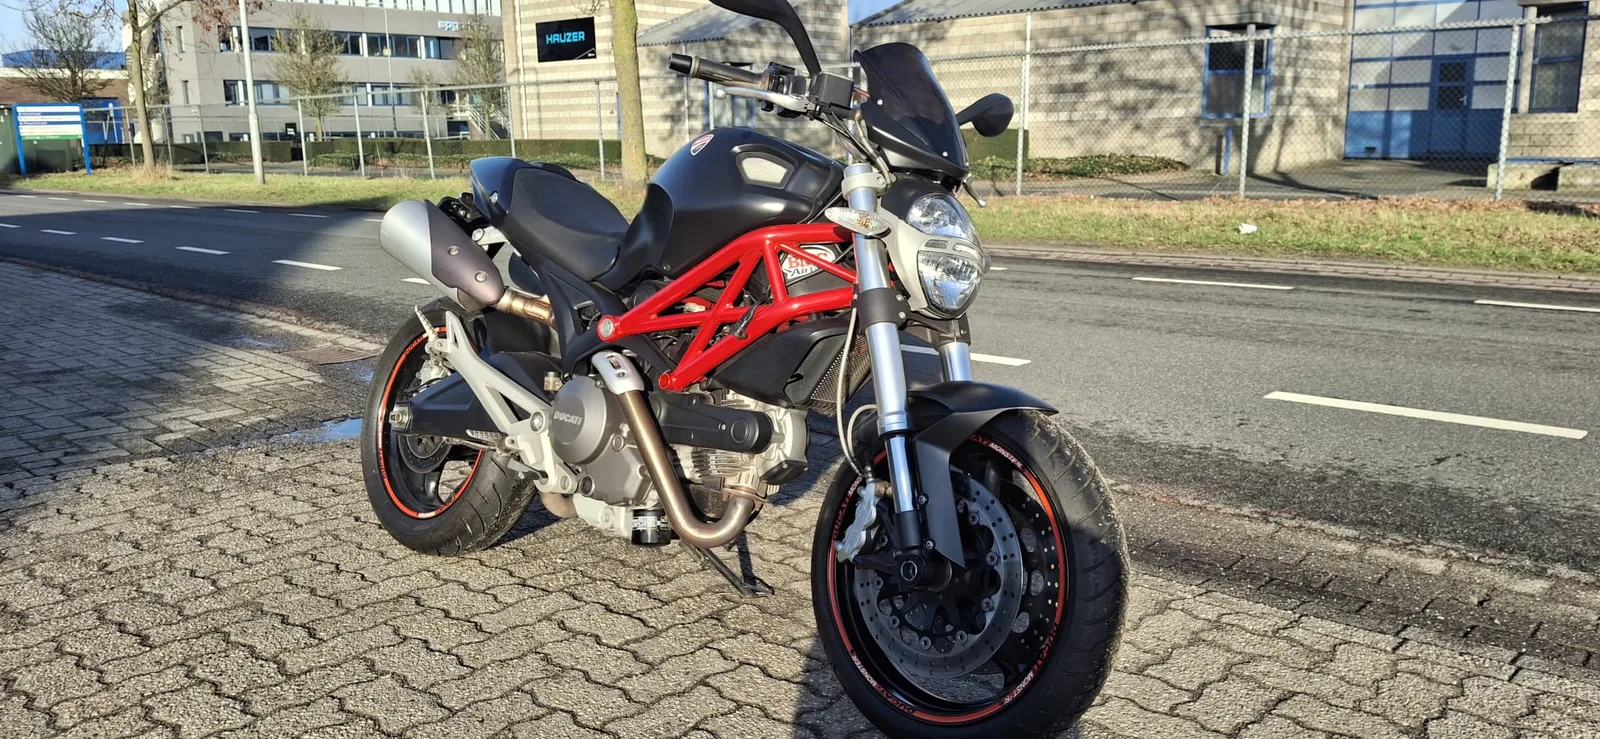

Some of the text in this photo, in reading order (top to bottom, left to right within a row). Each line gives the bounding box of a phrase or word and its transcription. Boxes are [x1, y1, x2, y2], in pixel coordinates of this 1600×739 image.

[545, 31, 586, 45] HAUZER
[553, 411, 583, 426] DUCATI
[989, 442, 1023, 470] MONSTER
[851, 654, 878, 688] MONSTER
